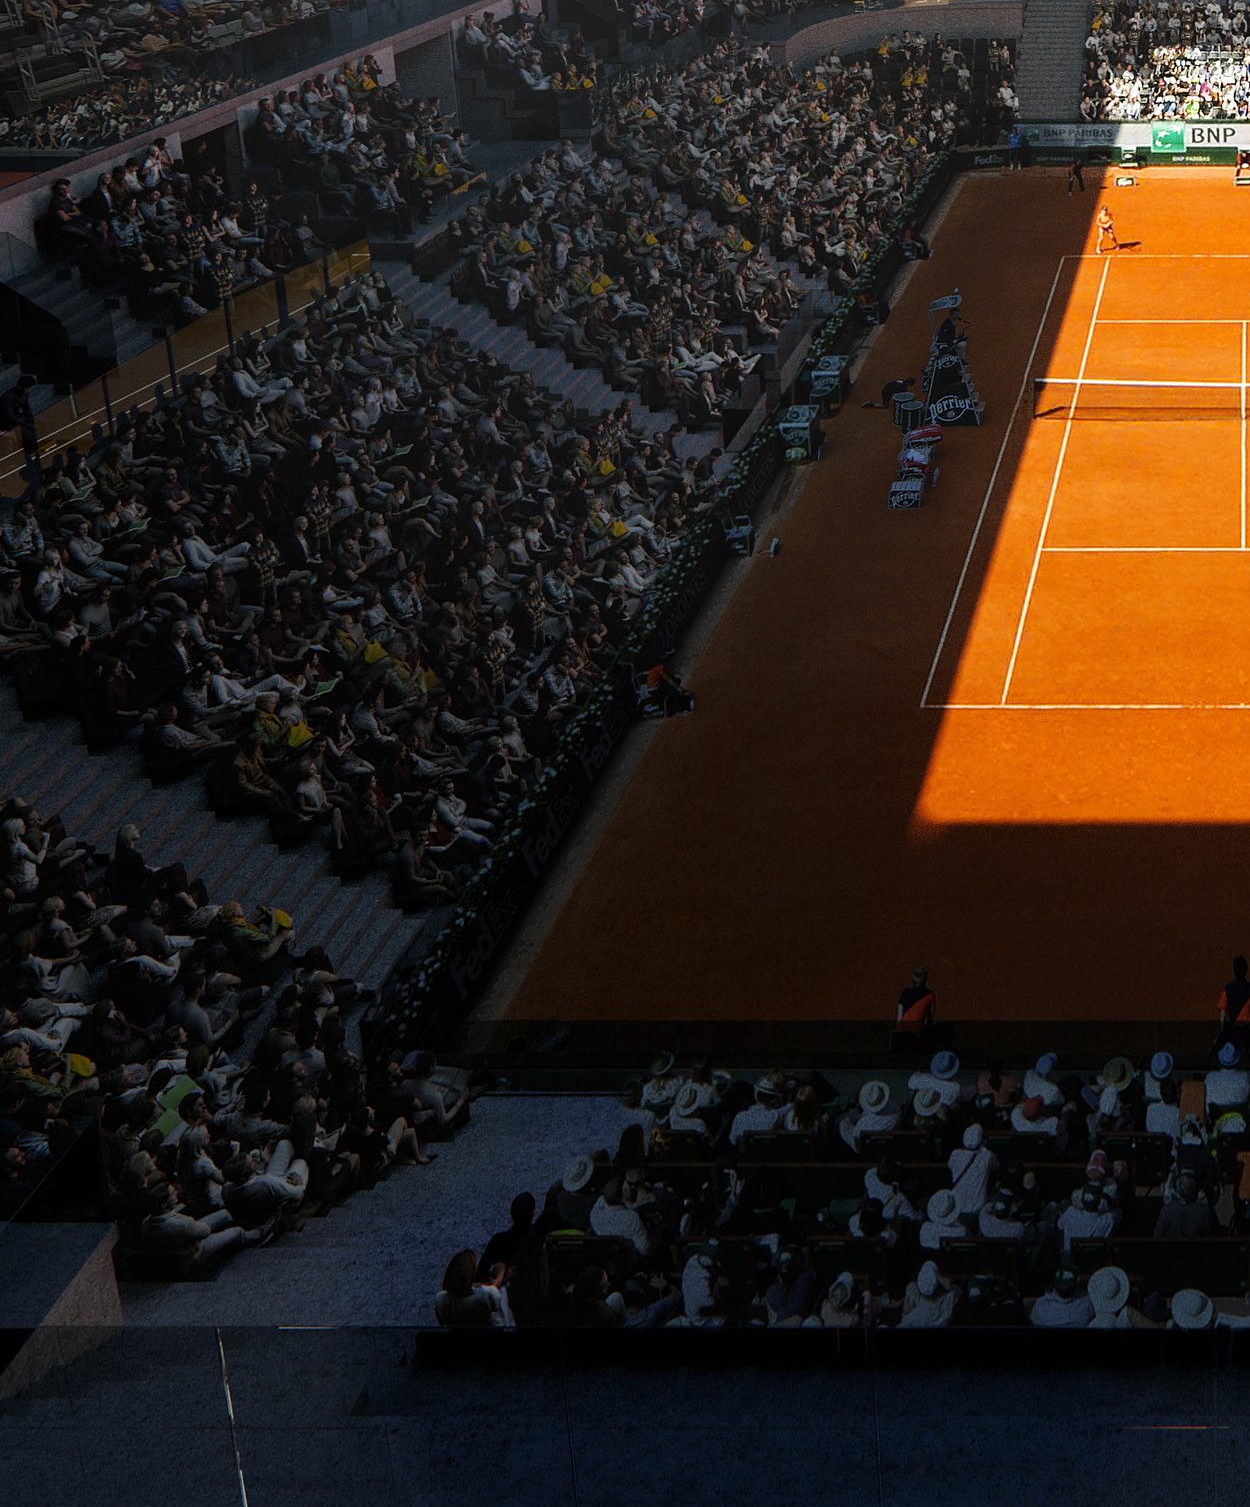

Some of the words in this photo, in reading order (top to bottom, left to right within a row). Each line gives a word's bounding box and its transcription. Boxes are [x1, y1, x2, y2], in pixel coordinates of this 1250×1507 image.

[1043, 128, 1066, 138] BNP
[1068, 128, 1113, 138] PARIBAS
[1192, 127, 1236, 143] BNP
